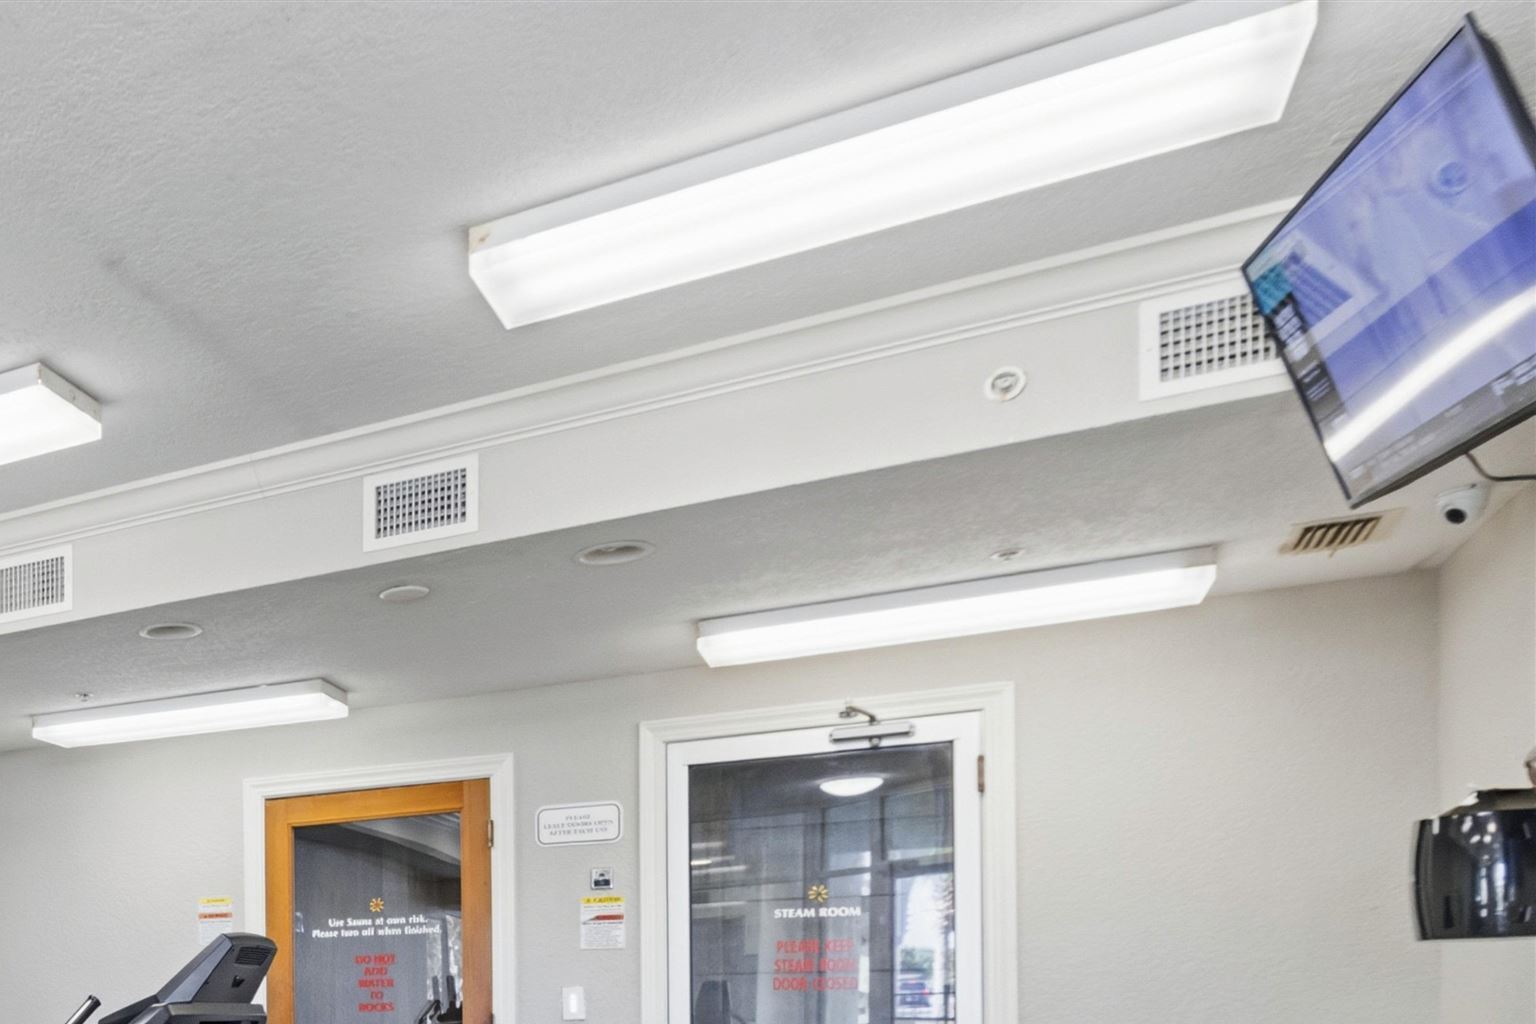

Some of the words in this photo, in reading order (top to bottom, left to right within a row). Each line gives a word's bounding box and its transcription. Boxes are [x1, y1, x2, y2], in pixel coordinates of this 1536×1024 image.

[774, 908, 816, 919] STEAM
[818, 906, 861, 917] ROOM
[328, 918, 345, 928] Use
[346, 917, 373, 927] Sauna
[375, 916, 384, 926] at
[386, 917, 406, 925] own
[408, 914, 428, 924] risk.
[312, 929, 339, 939] Please
[341, 927, 359, 938] turn
[362, 926, 375, 936] off
[378, 926, 402, 936] when
[404, 924, 442, 935] finished.
[357, 978, 395, 989] WATER
[358, 1002, 395, 1012] ROCKS
